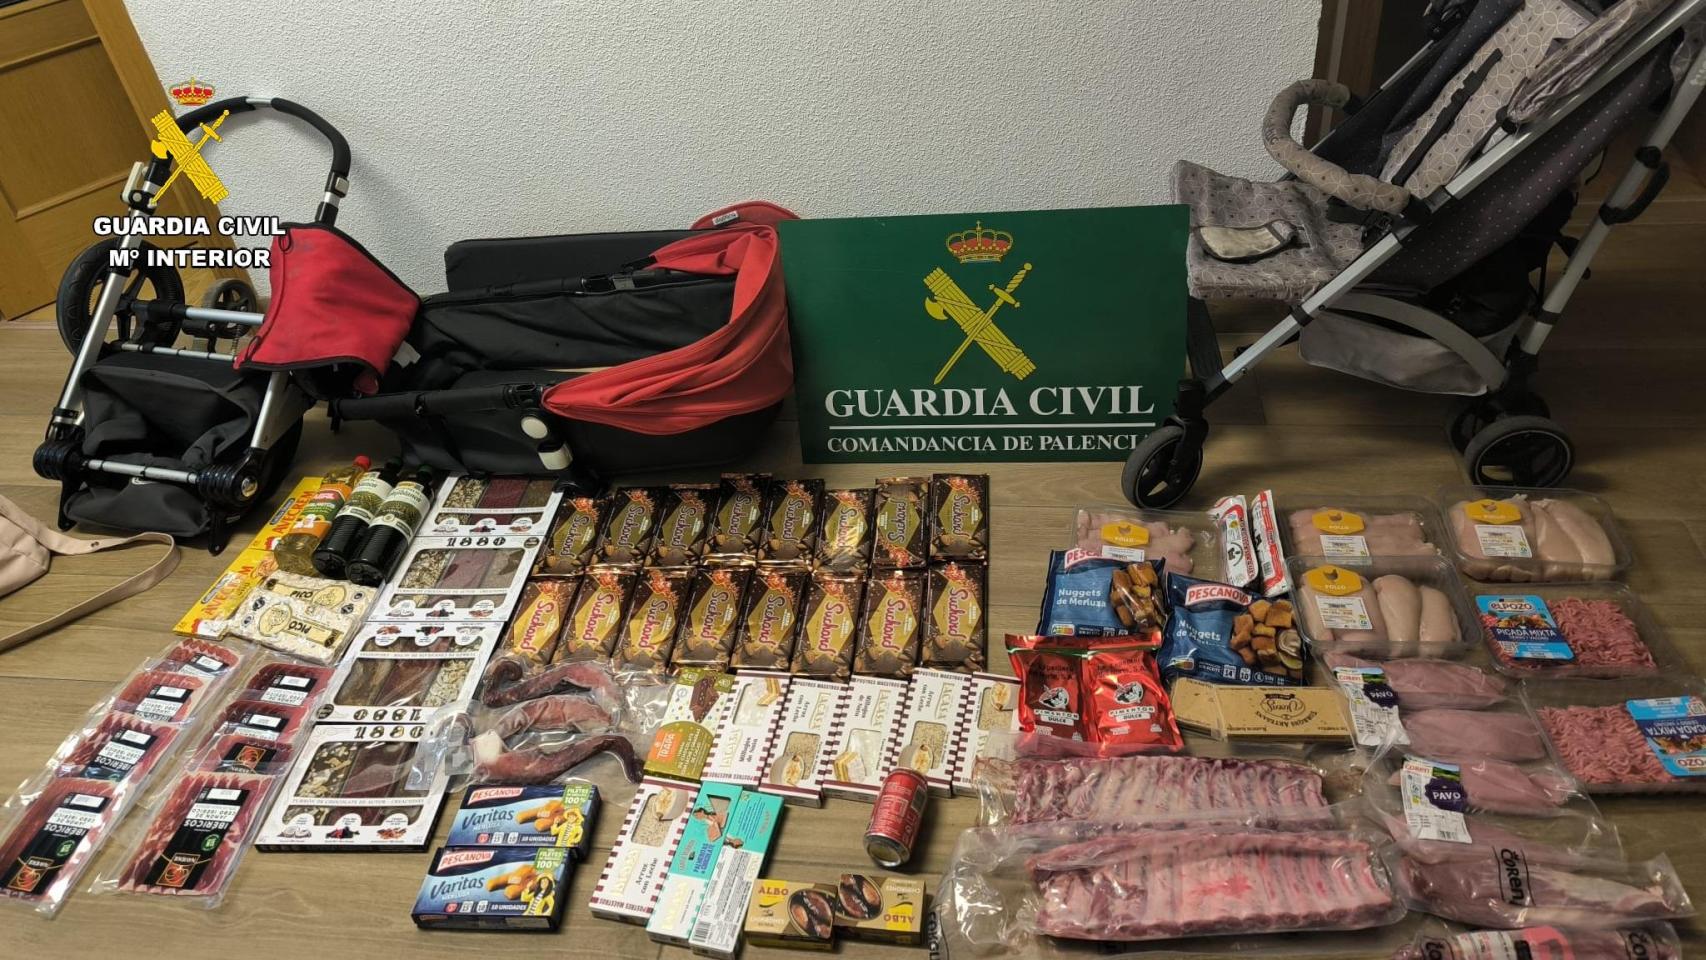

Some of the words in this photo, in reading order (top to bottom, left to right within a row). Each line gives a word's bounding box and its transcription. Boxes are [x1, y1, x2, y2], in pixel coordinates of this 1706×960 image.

[825, 387, 1017, 417] GUARDIA
[1029, 386, 1154, 416] CIVIL
[828, 436, 995, 453] COMANDANCIA
[1004, 435, 1033, 451] DE
[1040, 434, 1149, 451] PALENCI
[272, 491, 316, 534] AVECREM
[729, 494, 752, 537] Suchard
[783, 498, 804, 541] Suchard
[887, 500, 908, 543] Suchard
[951, 495, 972, 539] Suchard
[561, 515, 590, 559] Suchard
[618, 505, 645, 549] Suchard
[672, 506, 697, 550] Suchard
[1056, 597, 1068, 605] de
[1068, 597, 1107, 608] Merluza
[1058, 588, 1102, 598] Nuggets
[1187, 586, 1252, 605] PESCANOVA
[521, 601, 555, 652] Suchard
[583, 592, 614, 643] Suchard
[639, 600, 669, 652] Suchard
[701, 591, 729, 642] Suchard
[759, 594, 785, 647] Suchard
[883, 599, 907, 652] Suchard
[948, 589, 969, 640] Suchard
[818, 602, 844, 656] Suchard
[1176, 629, 1187, 637] de
[1496, 628, 1529, 637] PICADA
[1529, 629, 1556, 637] MIXTA
[1645, 726, 1677, 736] MIXTA
[1677, 724, 1706, 734] ICADA
[658, 733, 675, 757] TRAPA
[94, 755, 131, 770] IBÉRICOS
[472, 788, 521, 800] PESCANOVA
[1432, 792, 1461, 800] PAVO
[43, 823, 86, 837] IBÉRICOS
[184, 818, 228, 830] IBÉRICOS
[462, 809, 515, 830] Varitas
[442, 852, 492, 867] PESCANOVA
[430, 876, 485, 899] Varitas
[641, 880, 649, 894] con
[645, 857, 658, 878] Leche
[758, 887, 789, 896] ALBO
[883, 914, 915, 924] ALBO
